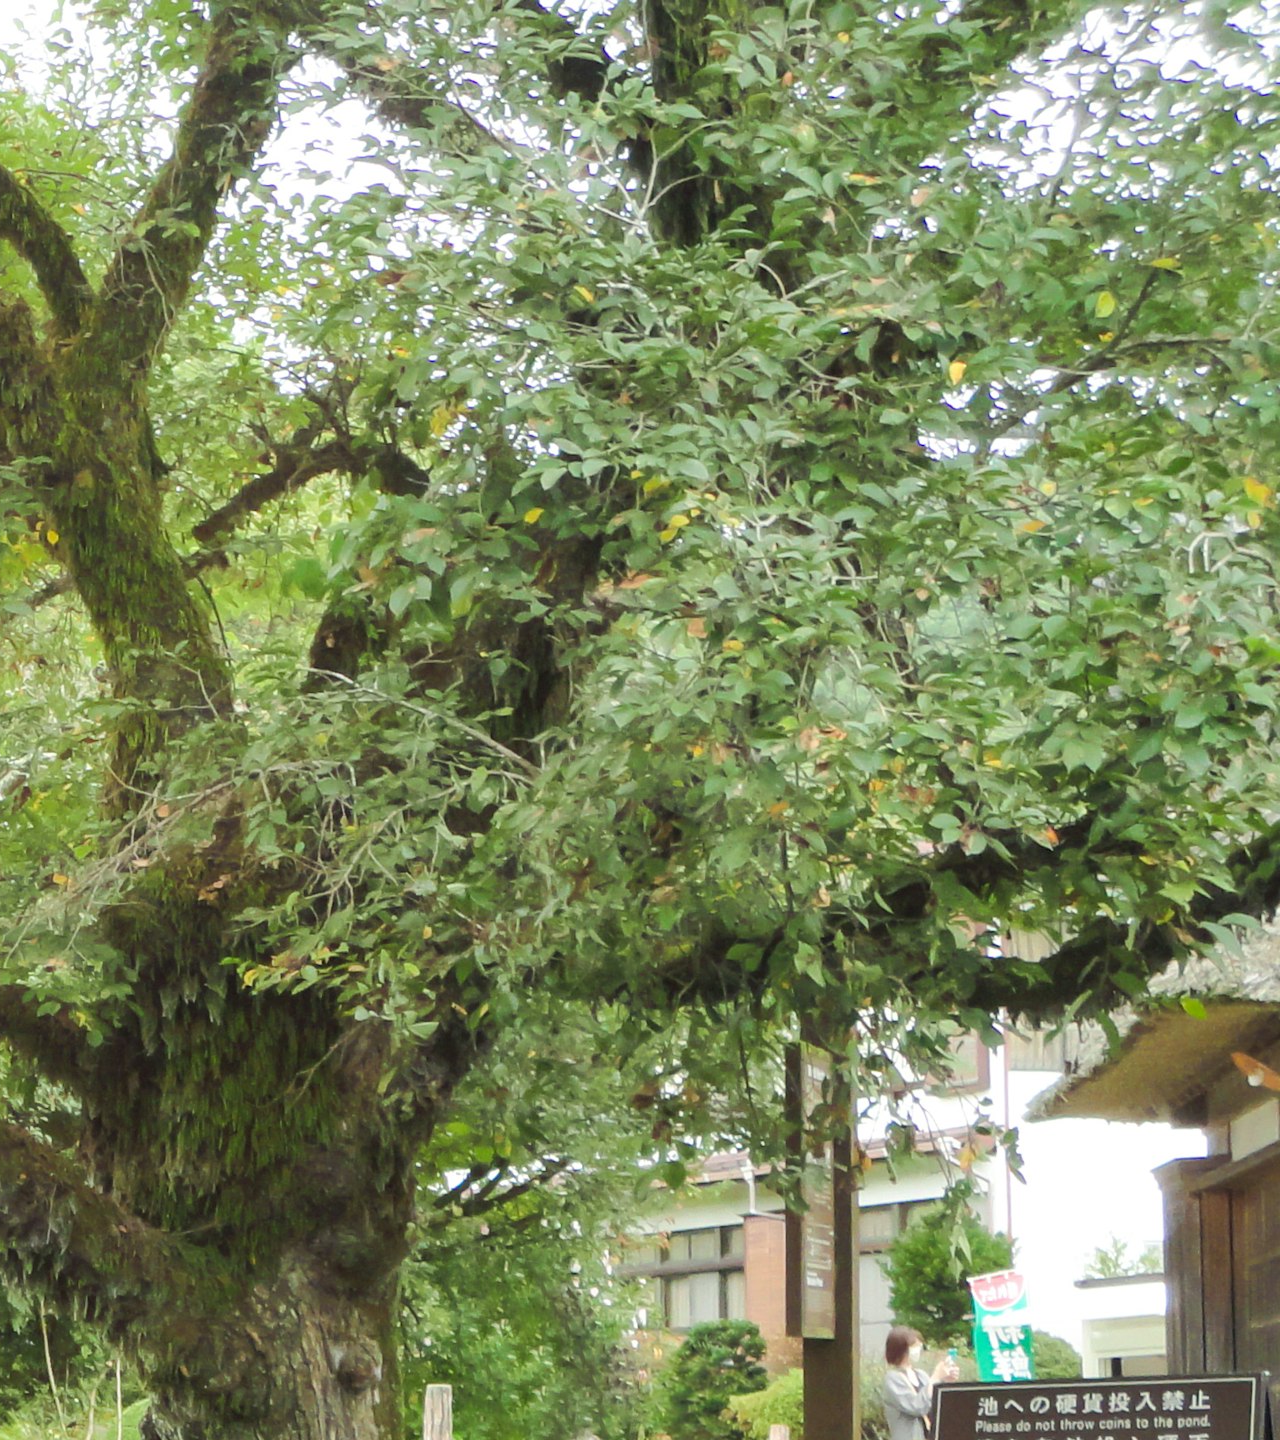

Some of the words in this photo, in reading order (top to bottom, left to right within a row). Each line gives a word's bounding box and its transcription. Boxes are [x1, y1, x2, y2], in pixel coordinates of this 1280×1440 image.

[977, 1389, 1211, 1416] 池への硬貨投入禁止
[975, 1420, 1012, 1433] Please
[1016, 1420, 1031, 1432] do
[1035, 1420, 1055, 1431] not
[1060, 1418, 1095, 1430] throw
[1099, 1417, 1131, 1430] coins
[1136, 1417, 1149, 1429] to
[1154, 1416, 1173, 1429] the
[1177, 1414, 1211, 1430] pond.
